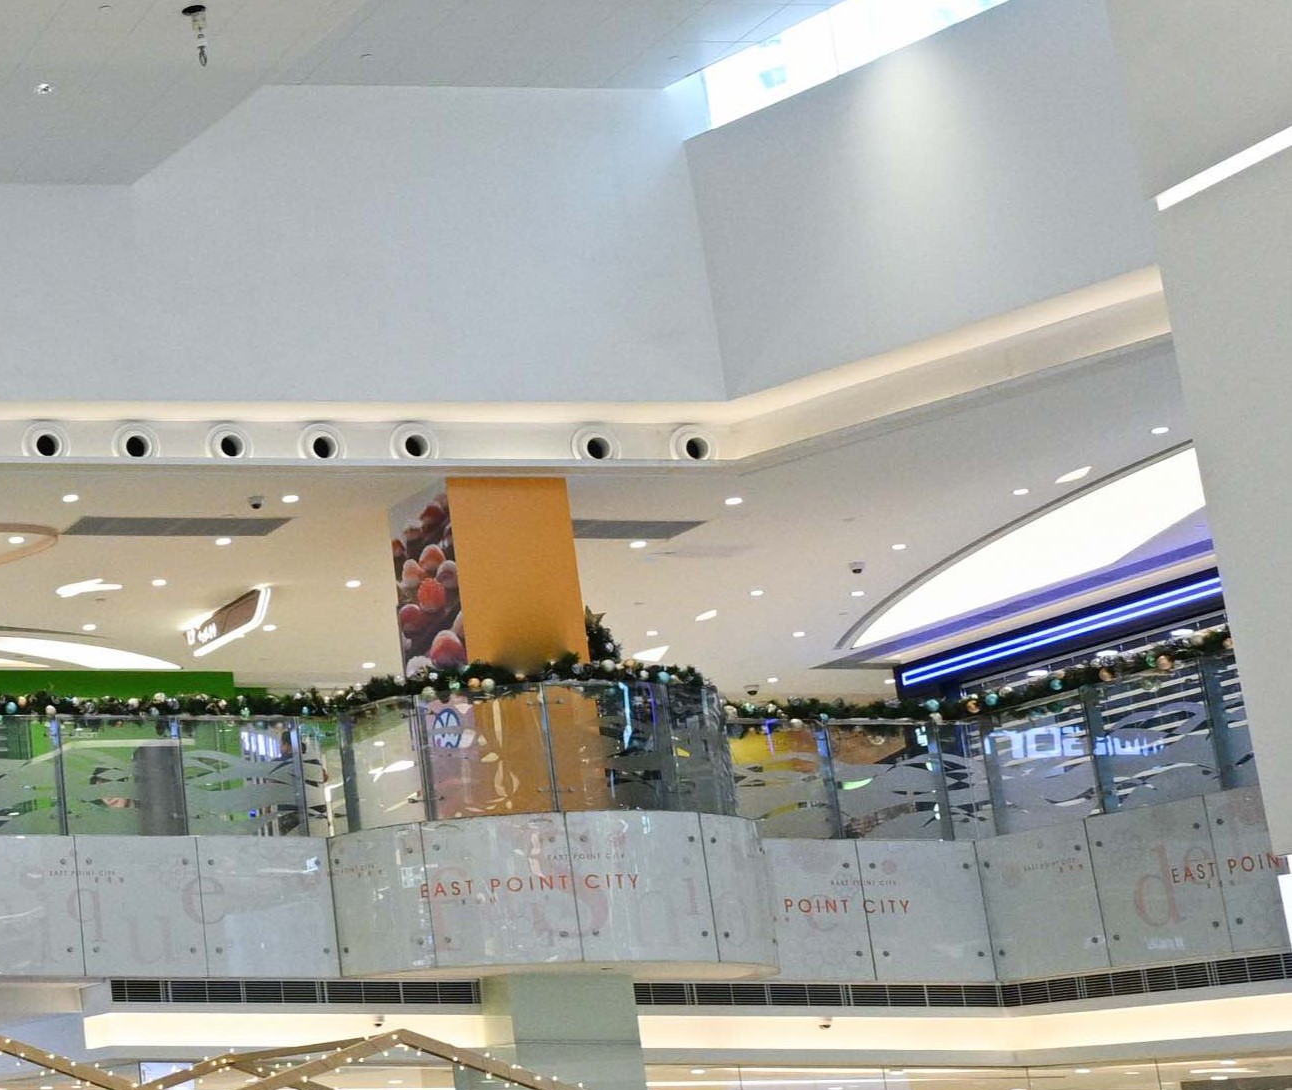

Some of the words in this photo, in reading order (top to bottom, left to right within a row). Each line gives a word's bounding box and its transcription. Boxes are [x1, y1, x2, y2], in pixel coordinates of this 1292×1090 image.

[1171, 862, 1215, 884] EAST
[1227, 852, 1284, 875] POIN
[421, 880, 474, 898] EAST
[490, 874, 569, 893] POINT
[585, 873, 640, 890] CITY
[784, 899, 850, 914] POINT
[863, 899, 910, 914] CITY
